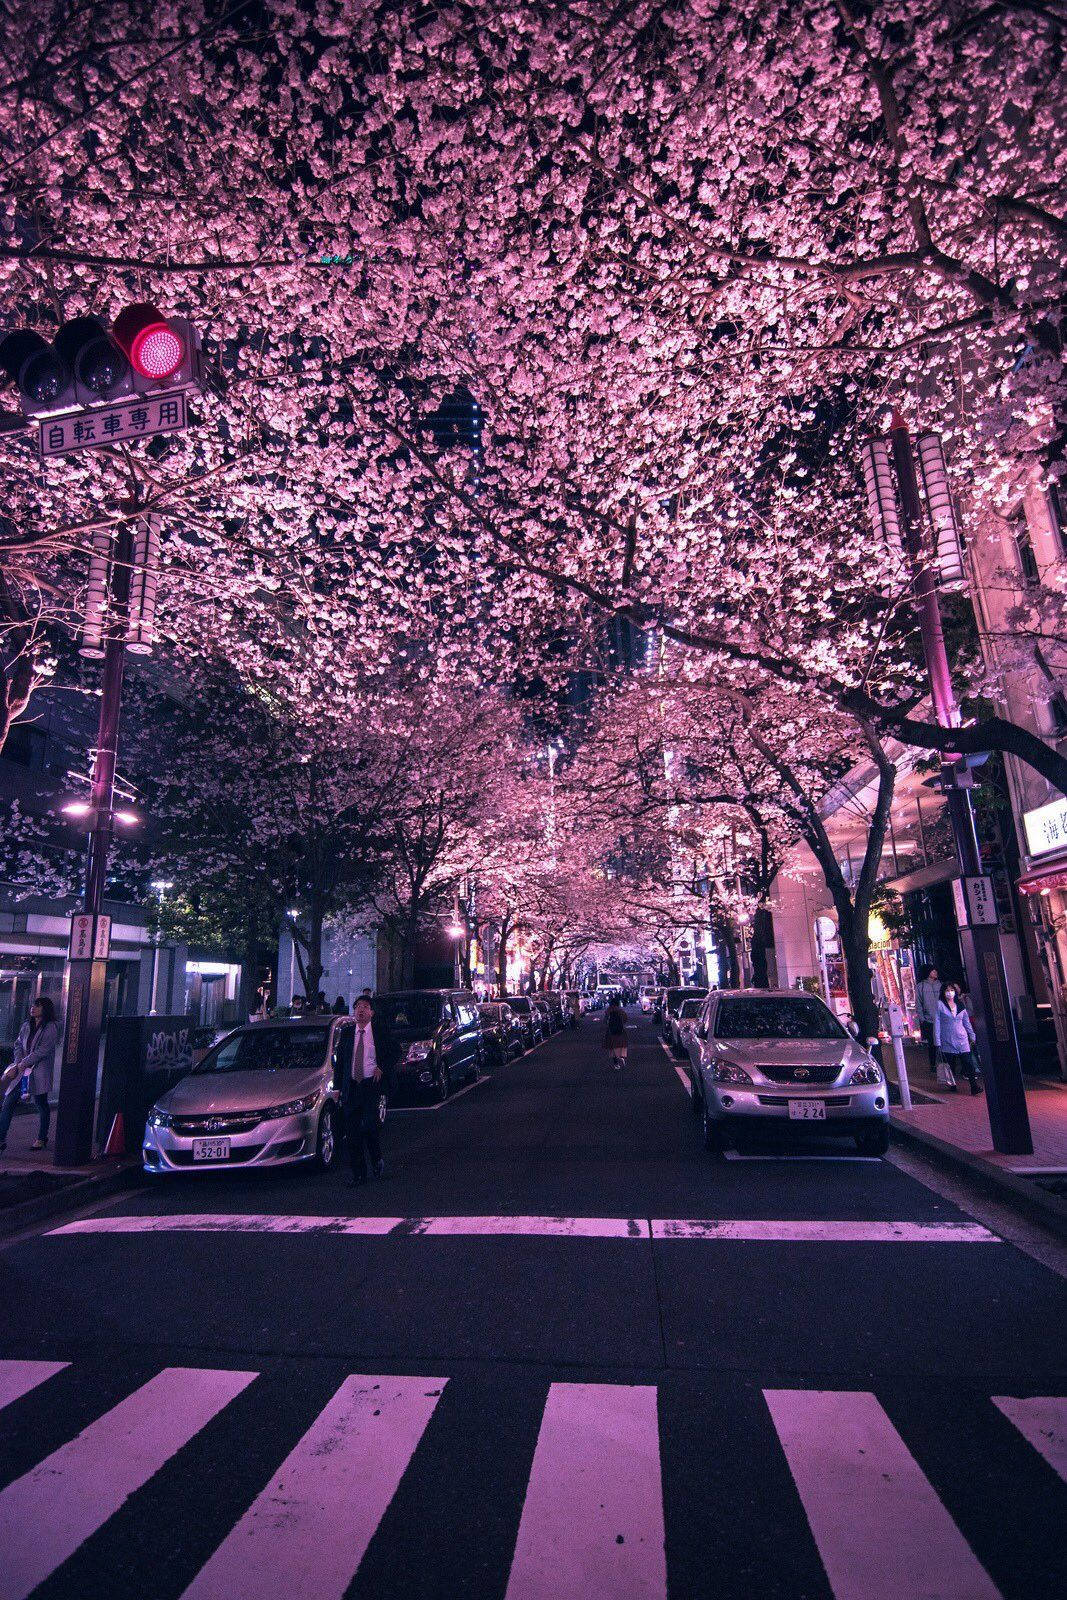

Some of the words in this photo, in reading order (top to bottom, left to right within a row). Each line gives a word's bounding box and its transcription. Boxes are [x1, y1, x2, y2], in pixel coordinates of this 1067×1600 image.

[48, 401, 179, 449] 自転車専用
[201, 1147, 227, 1158] 52-01
